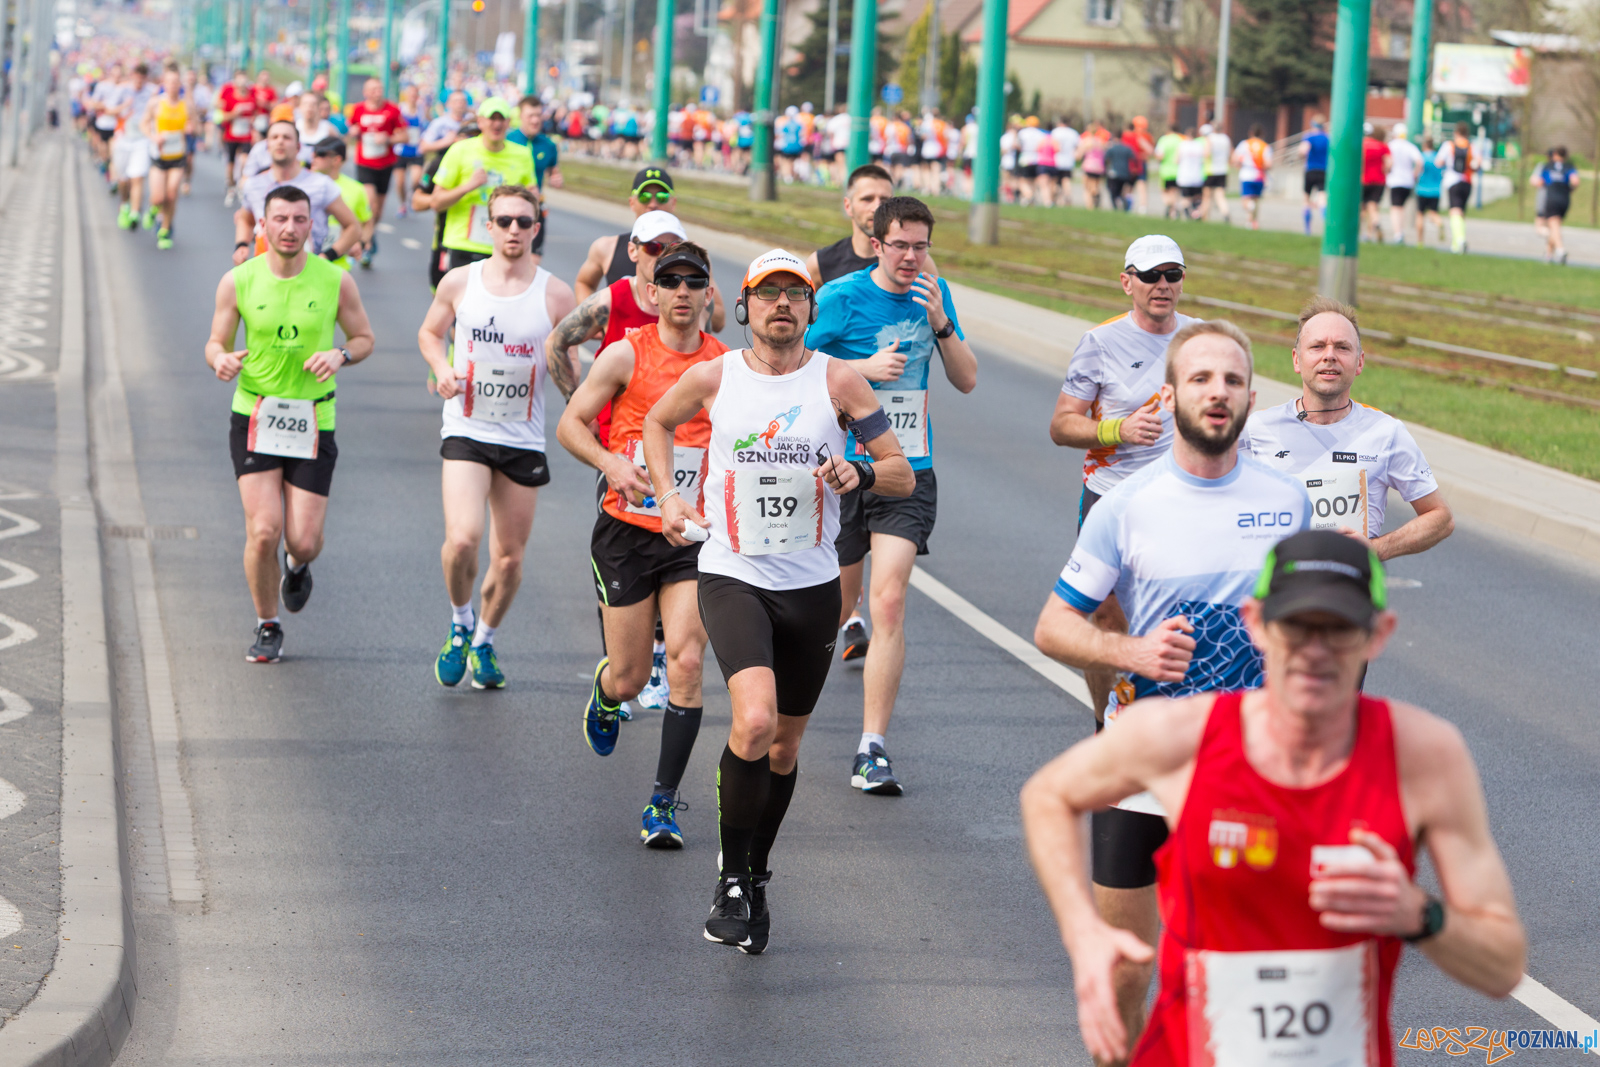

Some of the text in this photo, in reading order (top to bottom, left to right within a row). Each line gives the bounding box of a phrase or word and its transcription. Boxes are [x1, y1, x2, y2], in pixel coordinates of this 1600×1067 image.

[472, 328, 504, 343] RUN
[476, 381, 529, 398] 10700
[267, 415, 308, 433] 7628
[774, 443, 810, 452] JAK PO
[737, 451, 809, 464] SZNURKU
[673, 469, 697, 488] 97
[756, 496, 798, 518] 139
[1309, 494, 1360, 518] 007
[1238, 512, 1292, 527] arjo
[1252, 1002, 1331, 1039] 120
